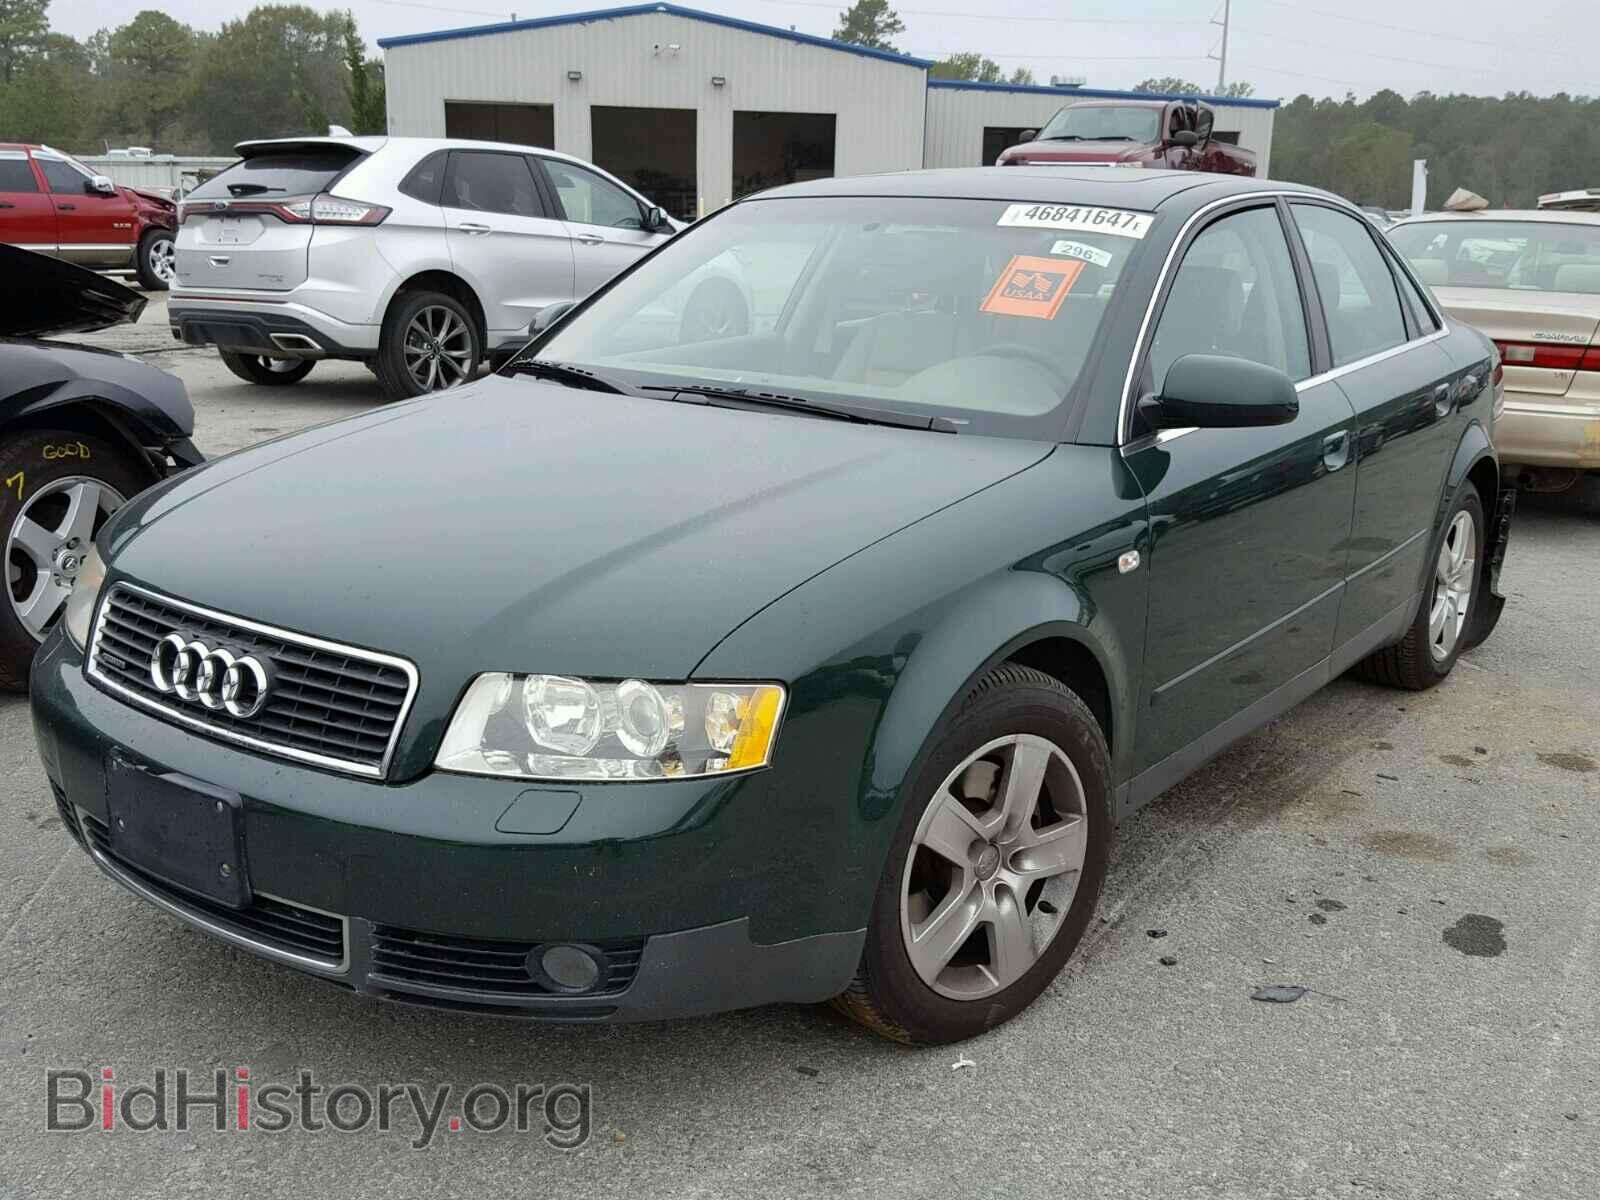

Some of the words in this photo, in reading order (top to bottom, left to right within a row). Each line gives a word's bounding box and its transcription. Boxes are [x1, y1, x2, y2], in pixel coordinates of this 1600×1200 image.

[1024, 205, 1137, 228] 46841647
[1004, 287, 1044, 299] USAA
[43, 441, 90, 458] GOOD
